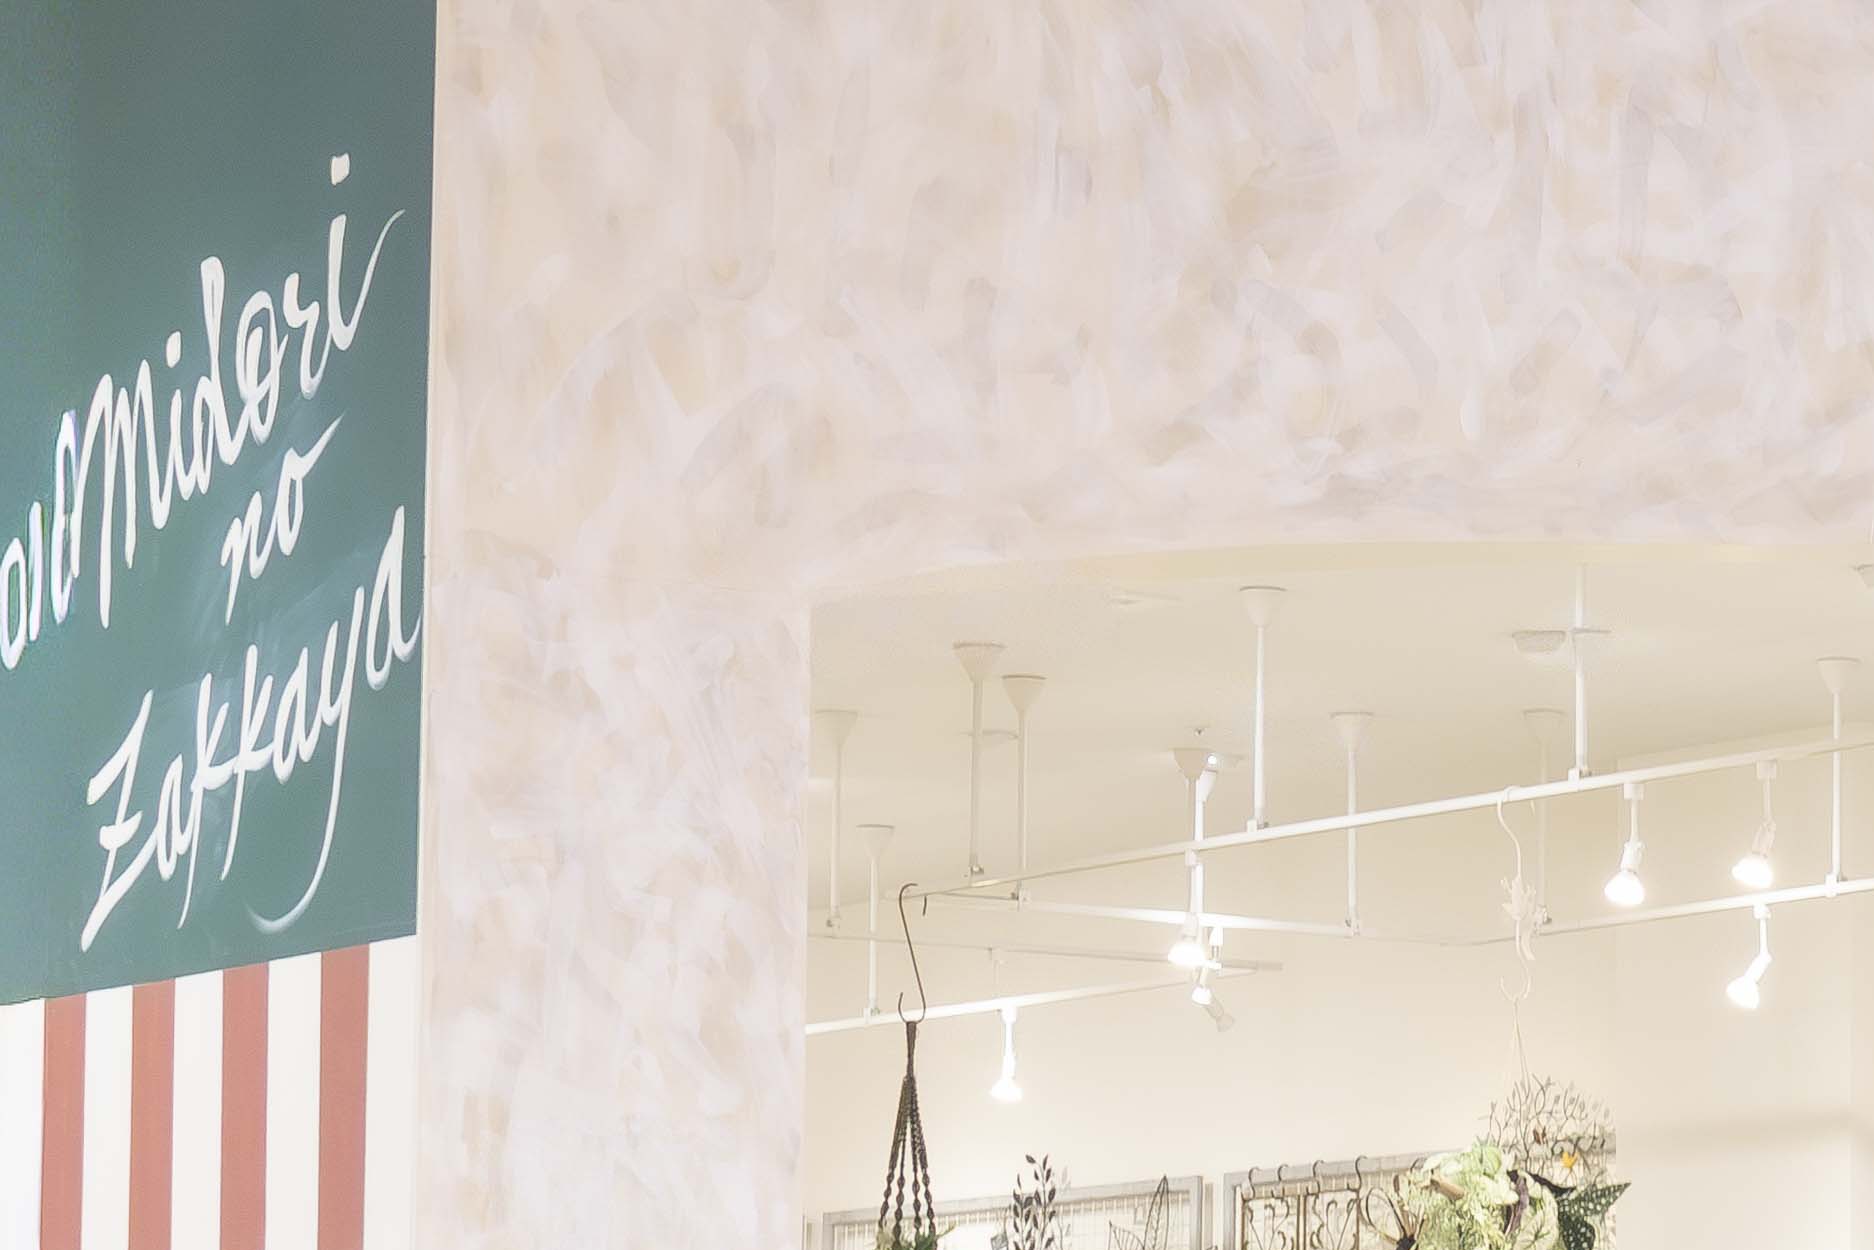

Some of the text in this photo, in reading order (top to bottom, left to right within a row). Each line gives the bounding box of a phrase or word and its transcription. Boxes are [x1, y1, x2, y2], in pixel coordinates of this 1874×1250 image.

[72, 152, 406, 628] Midori
[221, 410, 346, 626] no
[81, 504, 425, 954] Zakkaya
